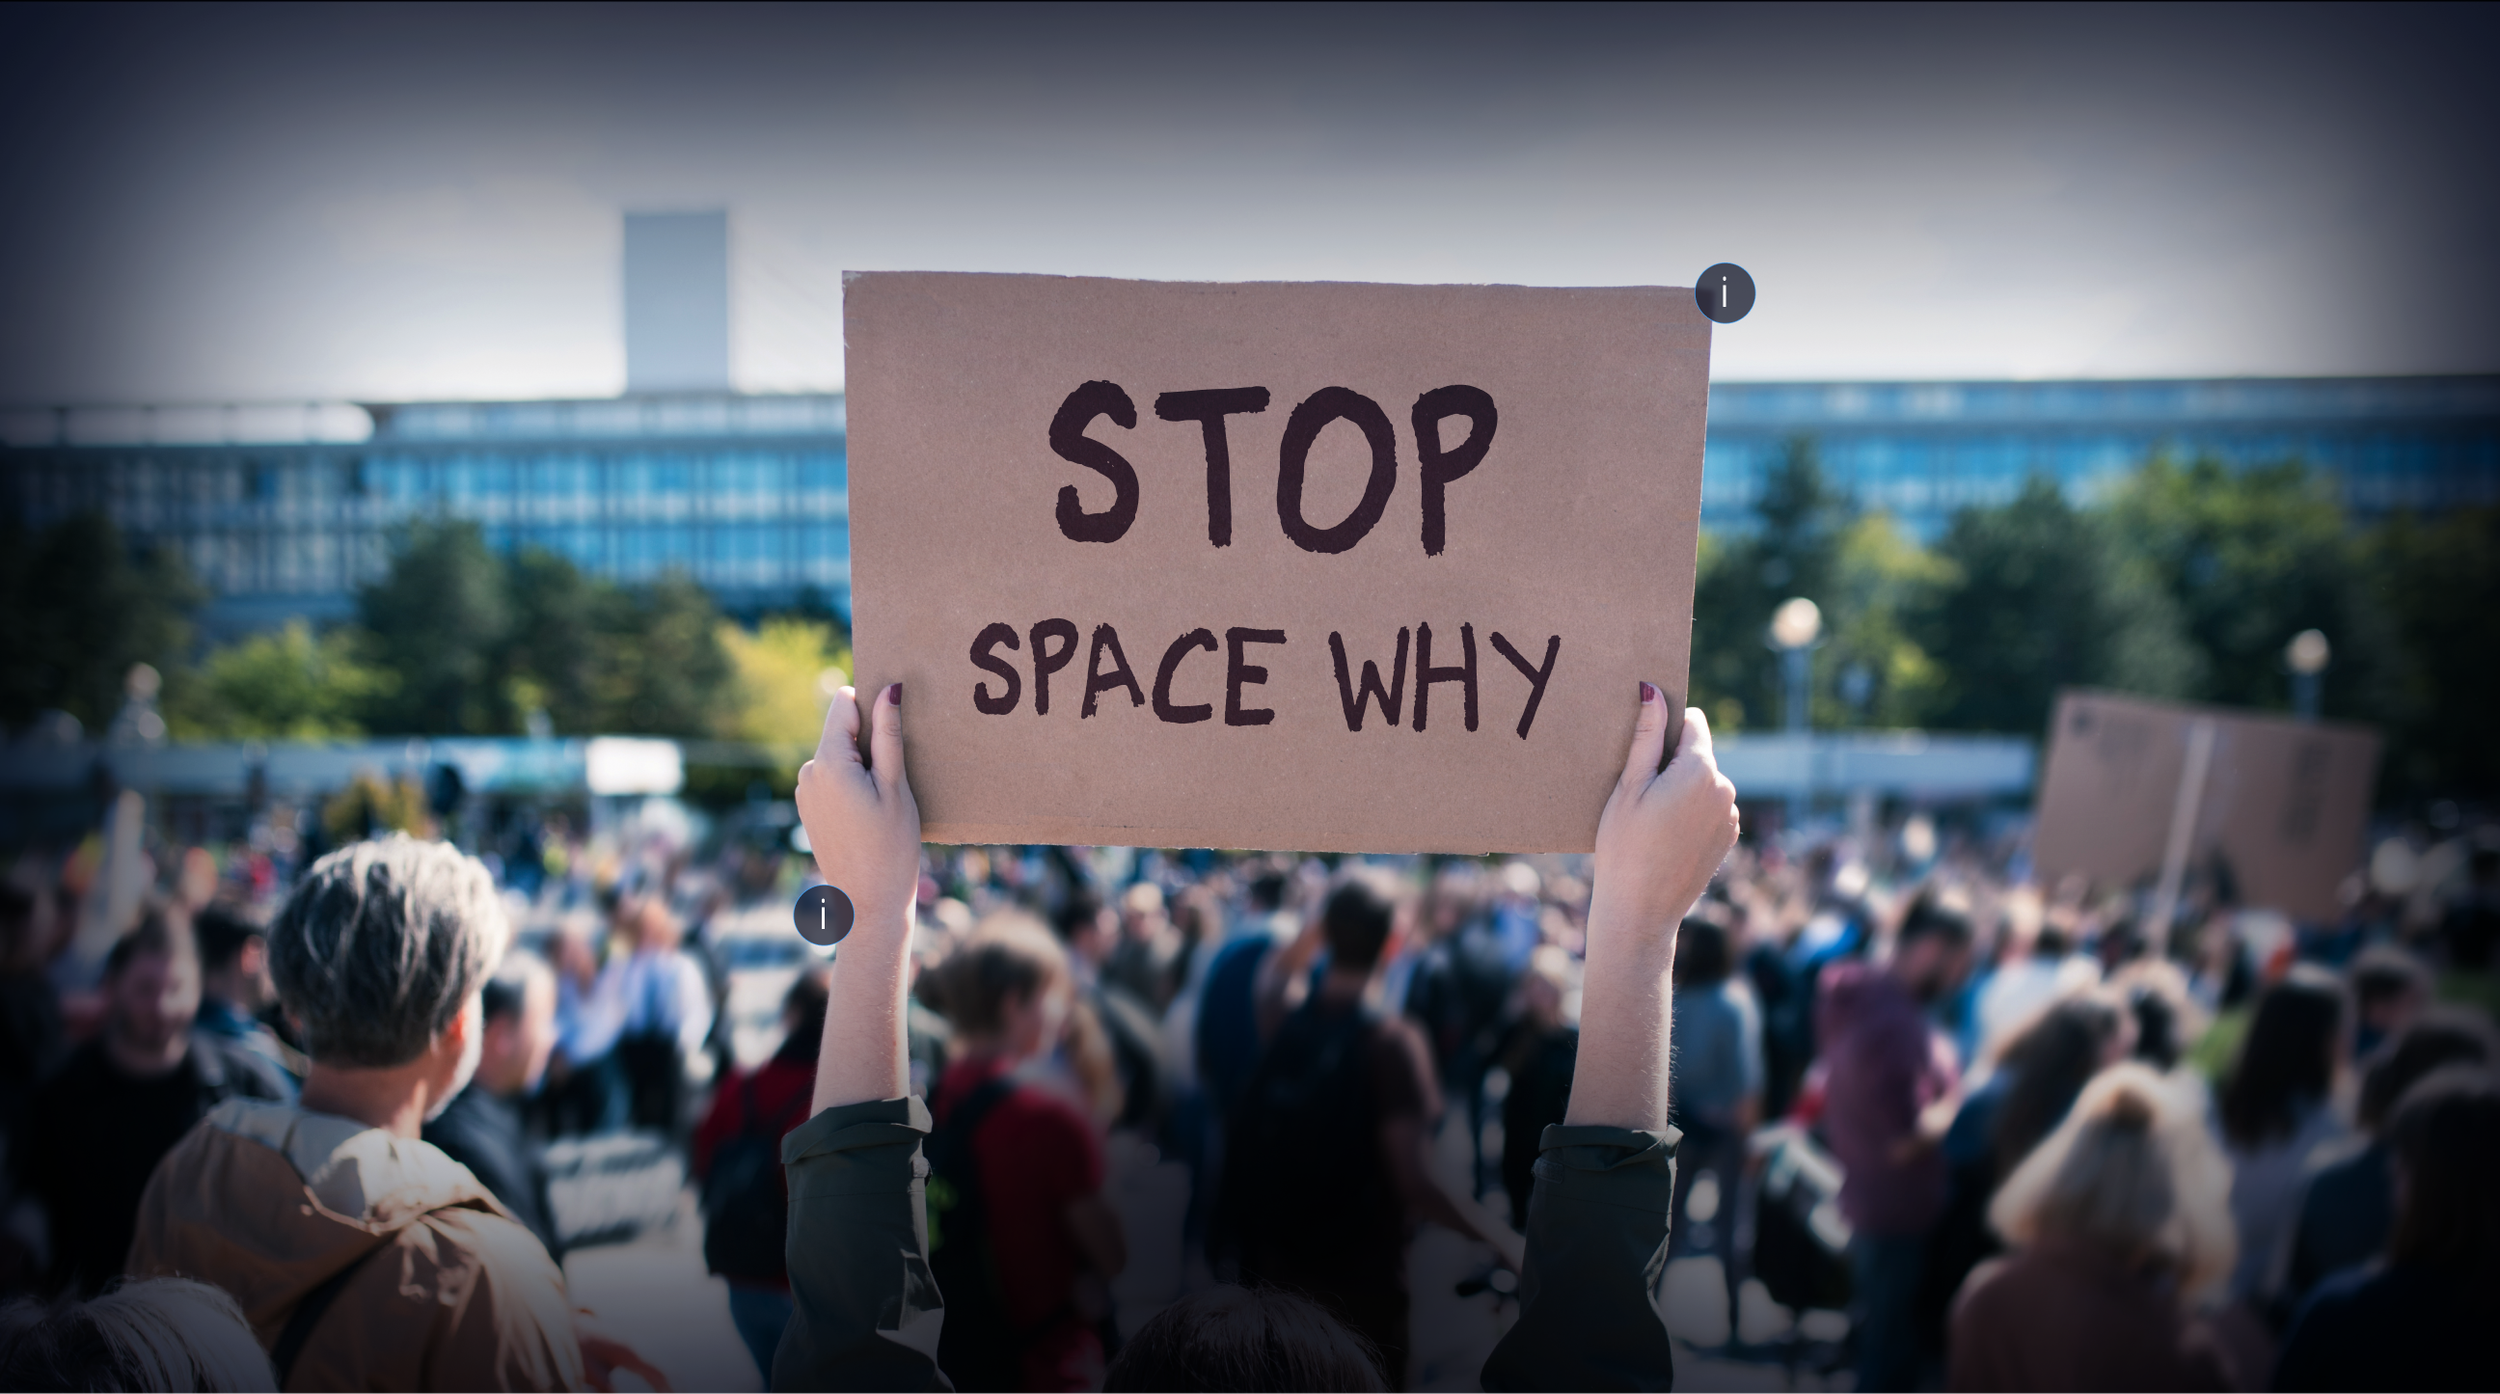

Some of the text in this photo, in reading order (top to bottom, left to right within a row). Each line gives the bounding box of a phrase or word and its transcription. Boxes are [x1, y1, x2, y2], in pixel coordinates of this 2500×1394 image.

[1048, 379, 1498, 559] STOP
[969, 618, 1561, 741] SPACE WHY
